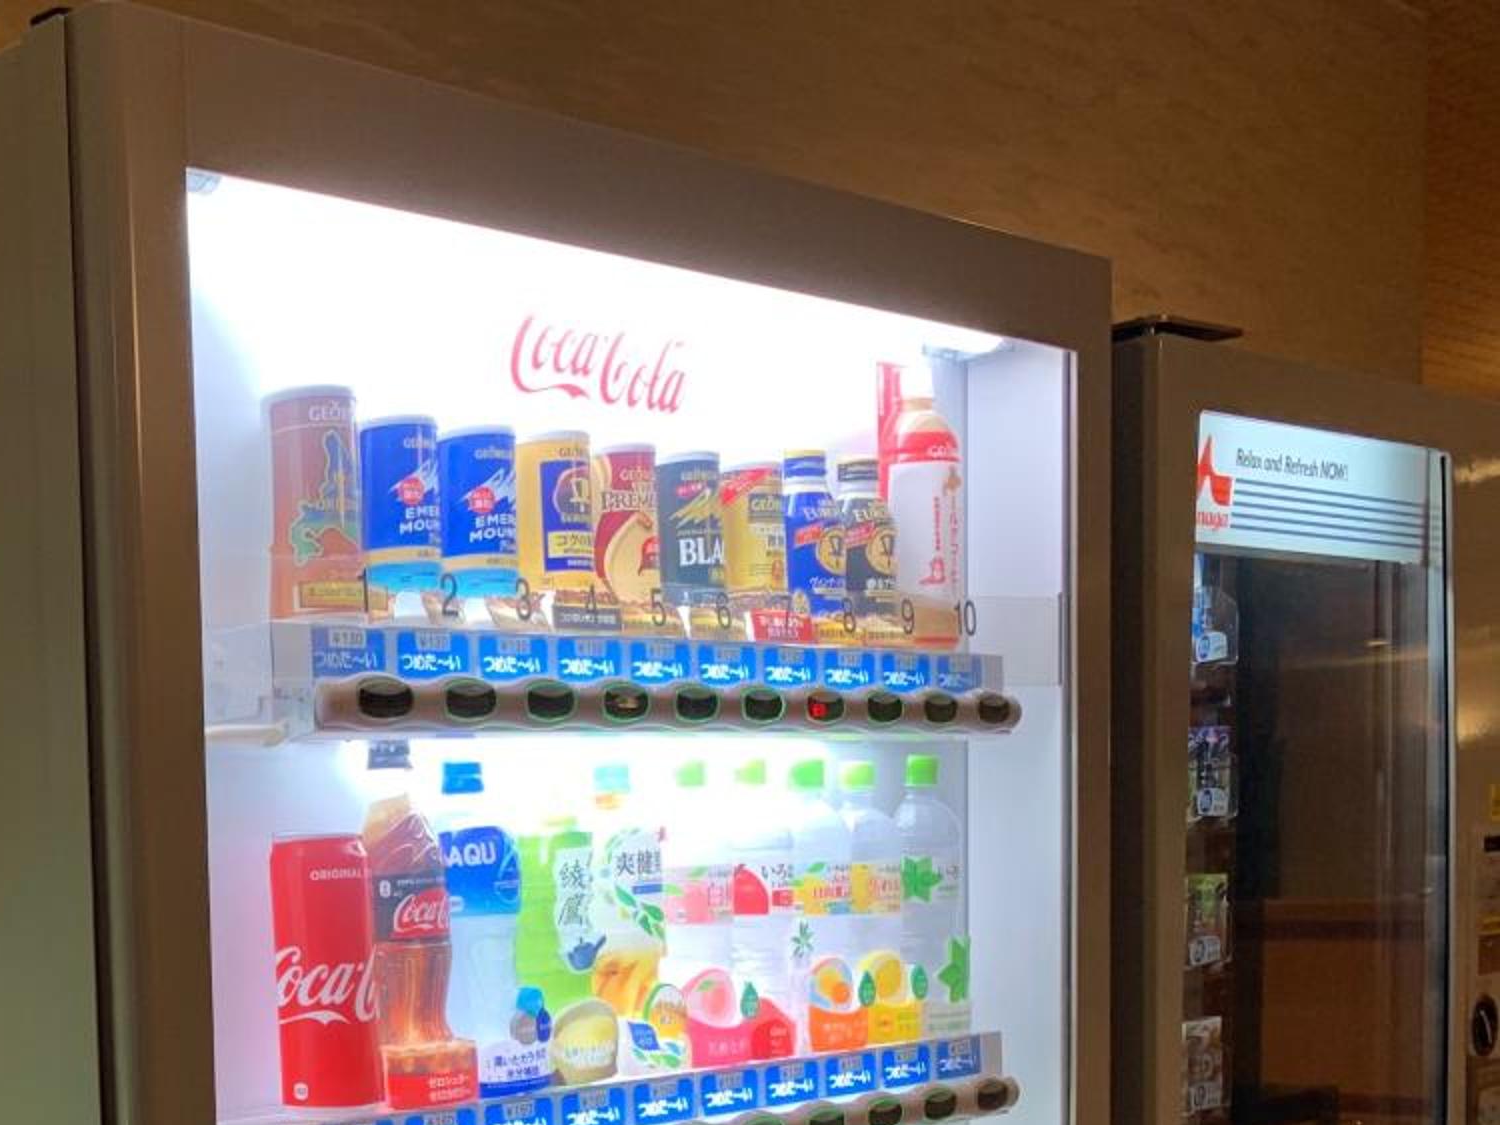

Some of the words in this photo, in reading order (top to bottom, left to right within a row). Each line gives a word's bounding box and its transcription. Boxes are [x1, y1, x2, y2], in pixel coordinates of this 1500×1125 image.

[1236, 448, 1262, 469] Relax
[1264, 453, 1283, 472] and
[1284, 455, 1318, 477] Refresh
[901, 598, 915, 635] 9
[953, 600, 977, 636] 10
